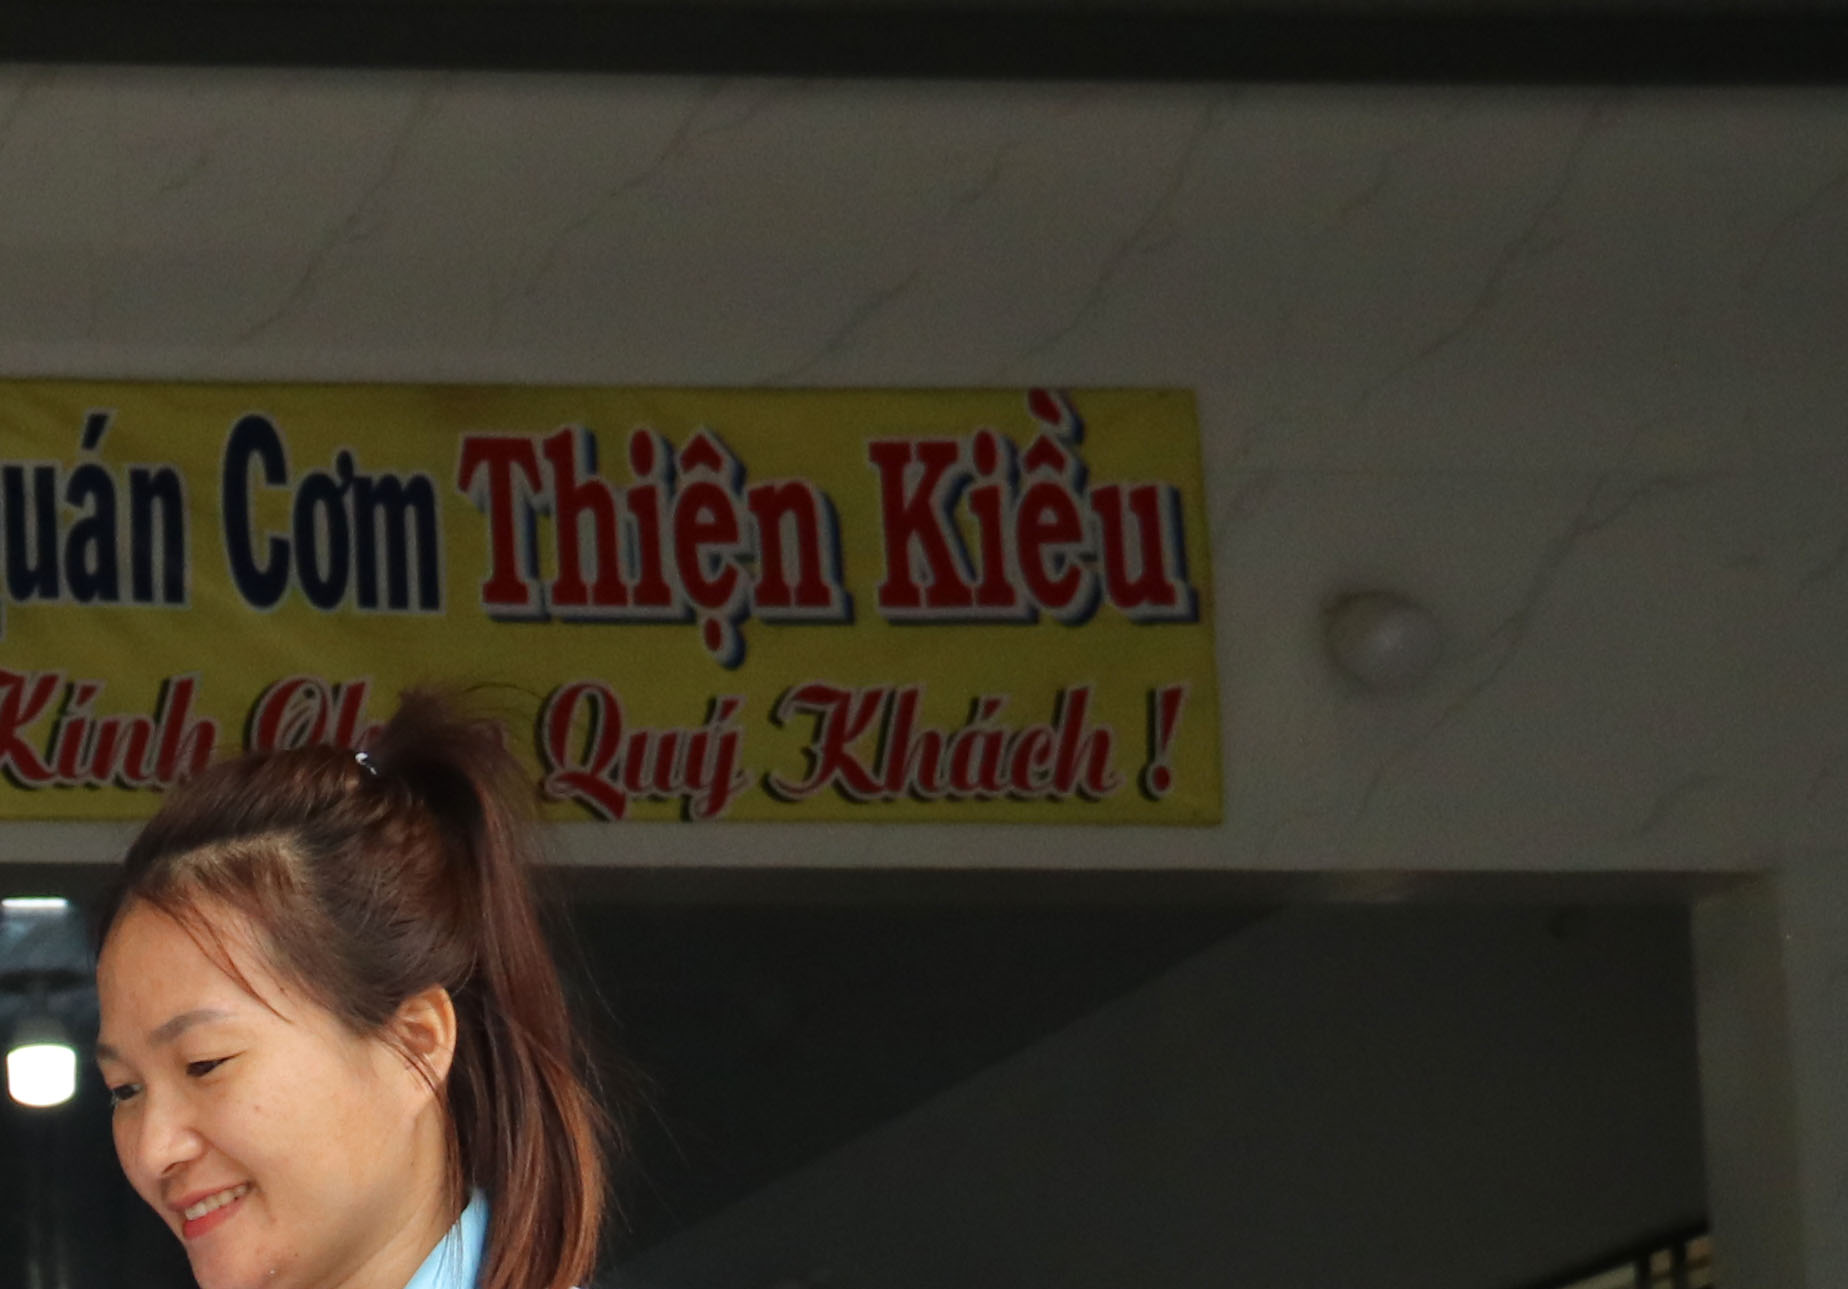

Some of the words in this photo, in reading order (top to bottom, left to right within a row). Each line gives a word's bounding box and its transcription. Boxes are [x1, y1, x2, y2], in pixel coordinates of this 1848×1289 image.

[221, 413, 442, 610] Cơm
[457, 424, 849, 668] Thiện
[868, 387, 1197, 621] Kiều
[538, 681, 751, 822] Quý
[764, 681, 1124, 801] Khách
